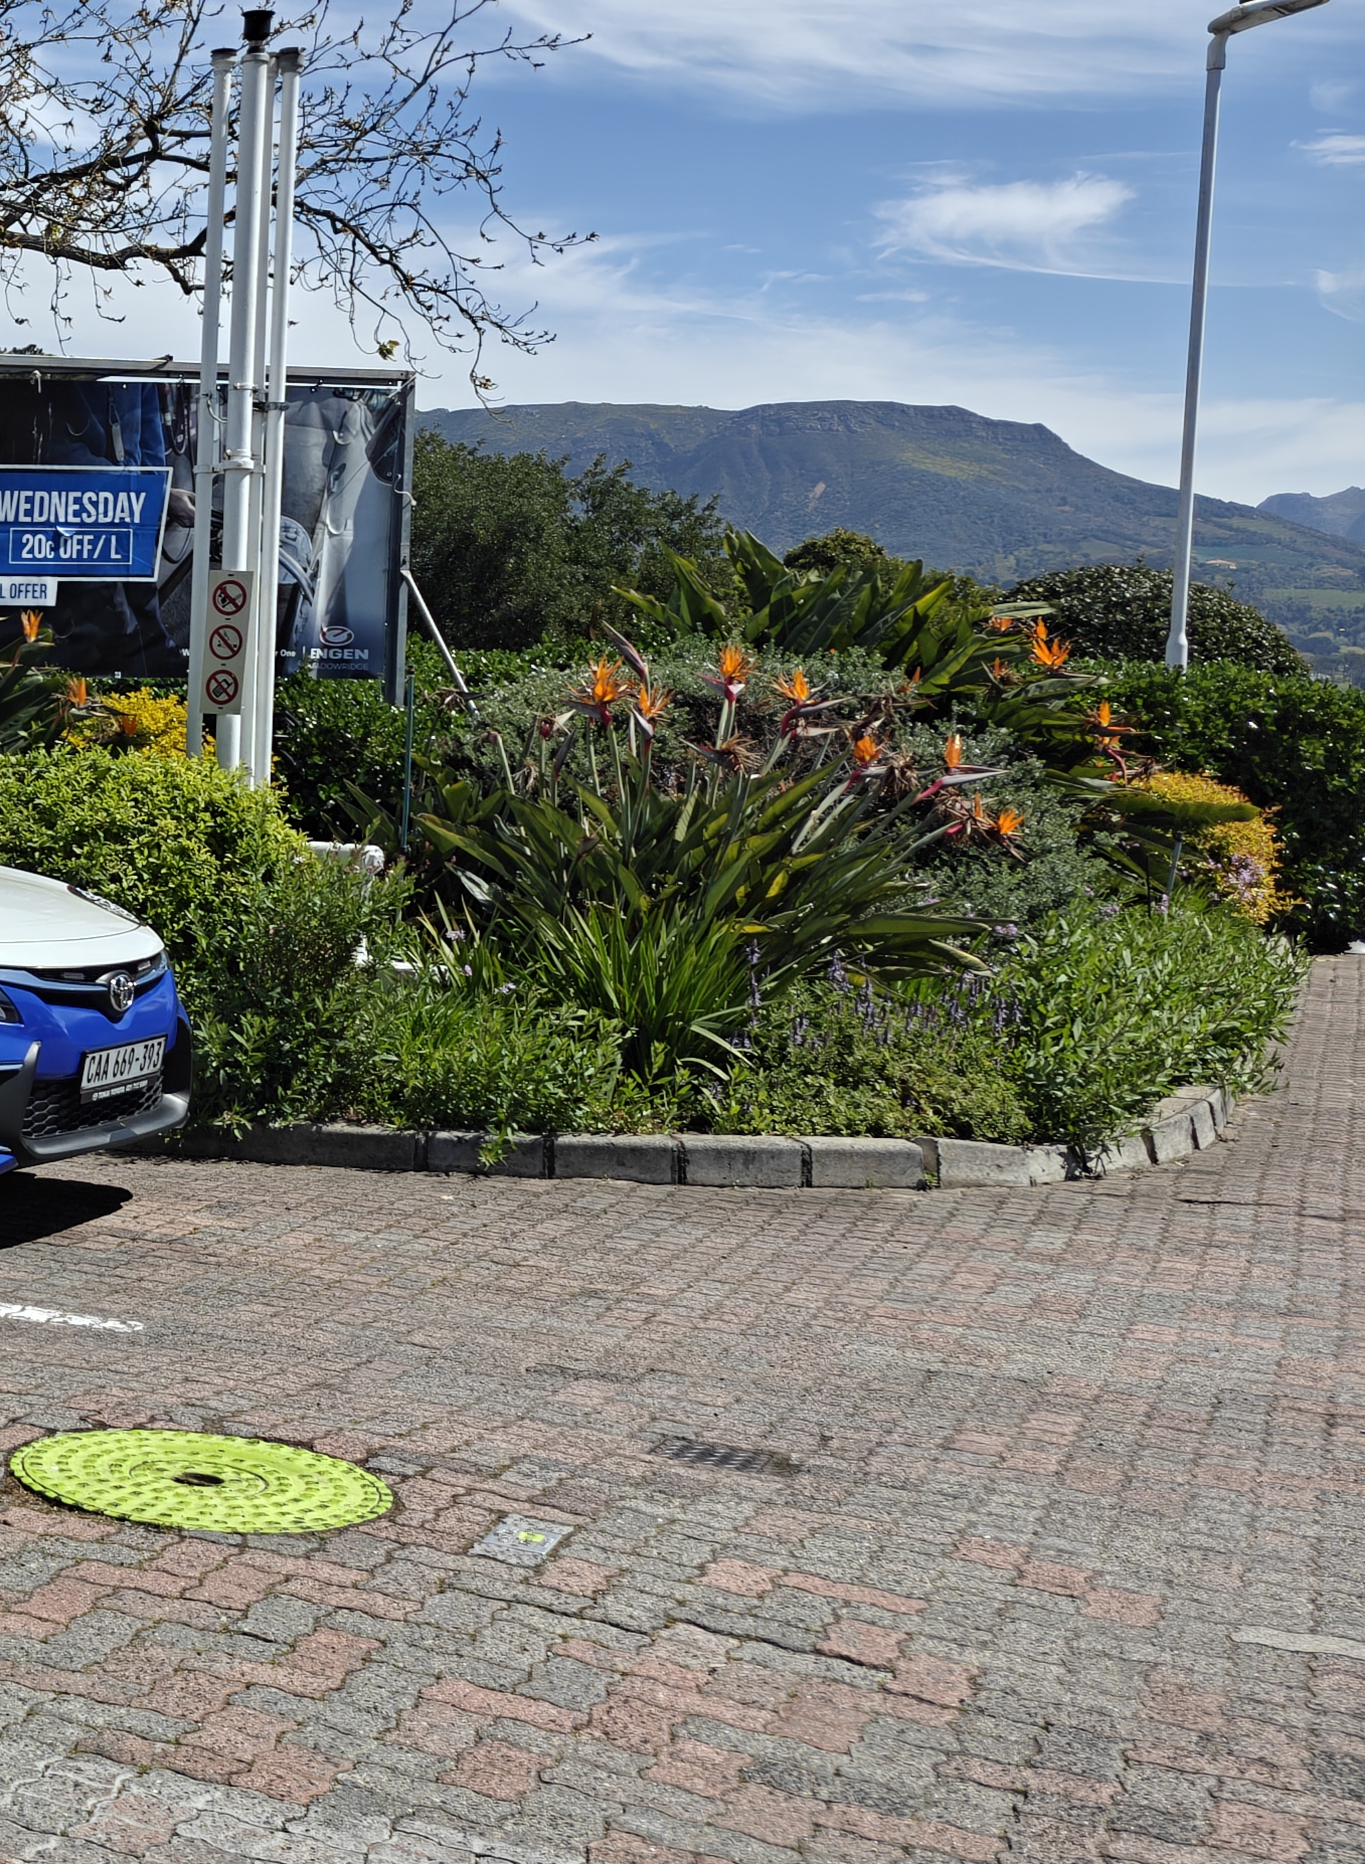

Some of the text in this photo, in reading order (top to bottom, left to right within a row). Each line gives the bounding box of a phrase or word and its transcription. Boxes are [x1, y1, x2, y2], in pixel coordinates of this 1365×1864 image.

[21, 533, 55, 559] 20c
[111, 534, 121, 559] L
[10, 582, 47, 600] OFFER
[310, 647, 369, 660] ENGEN
[86, 1041, 162, 1084] CAA 669-393
